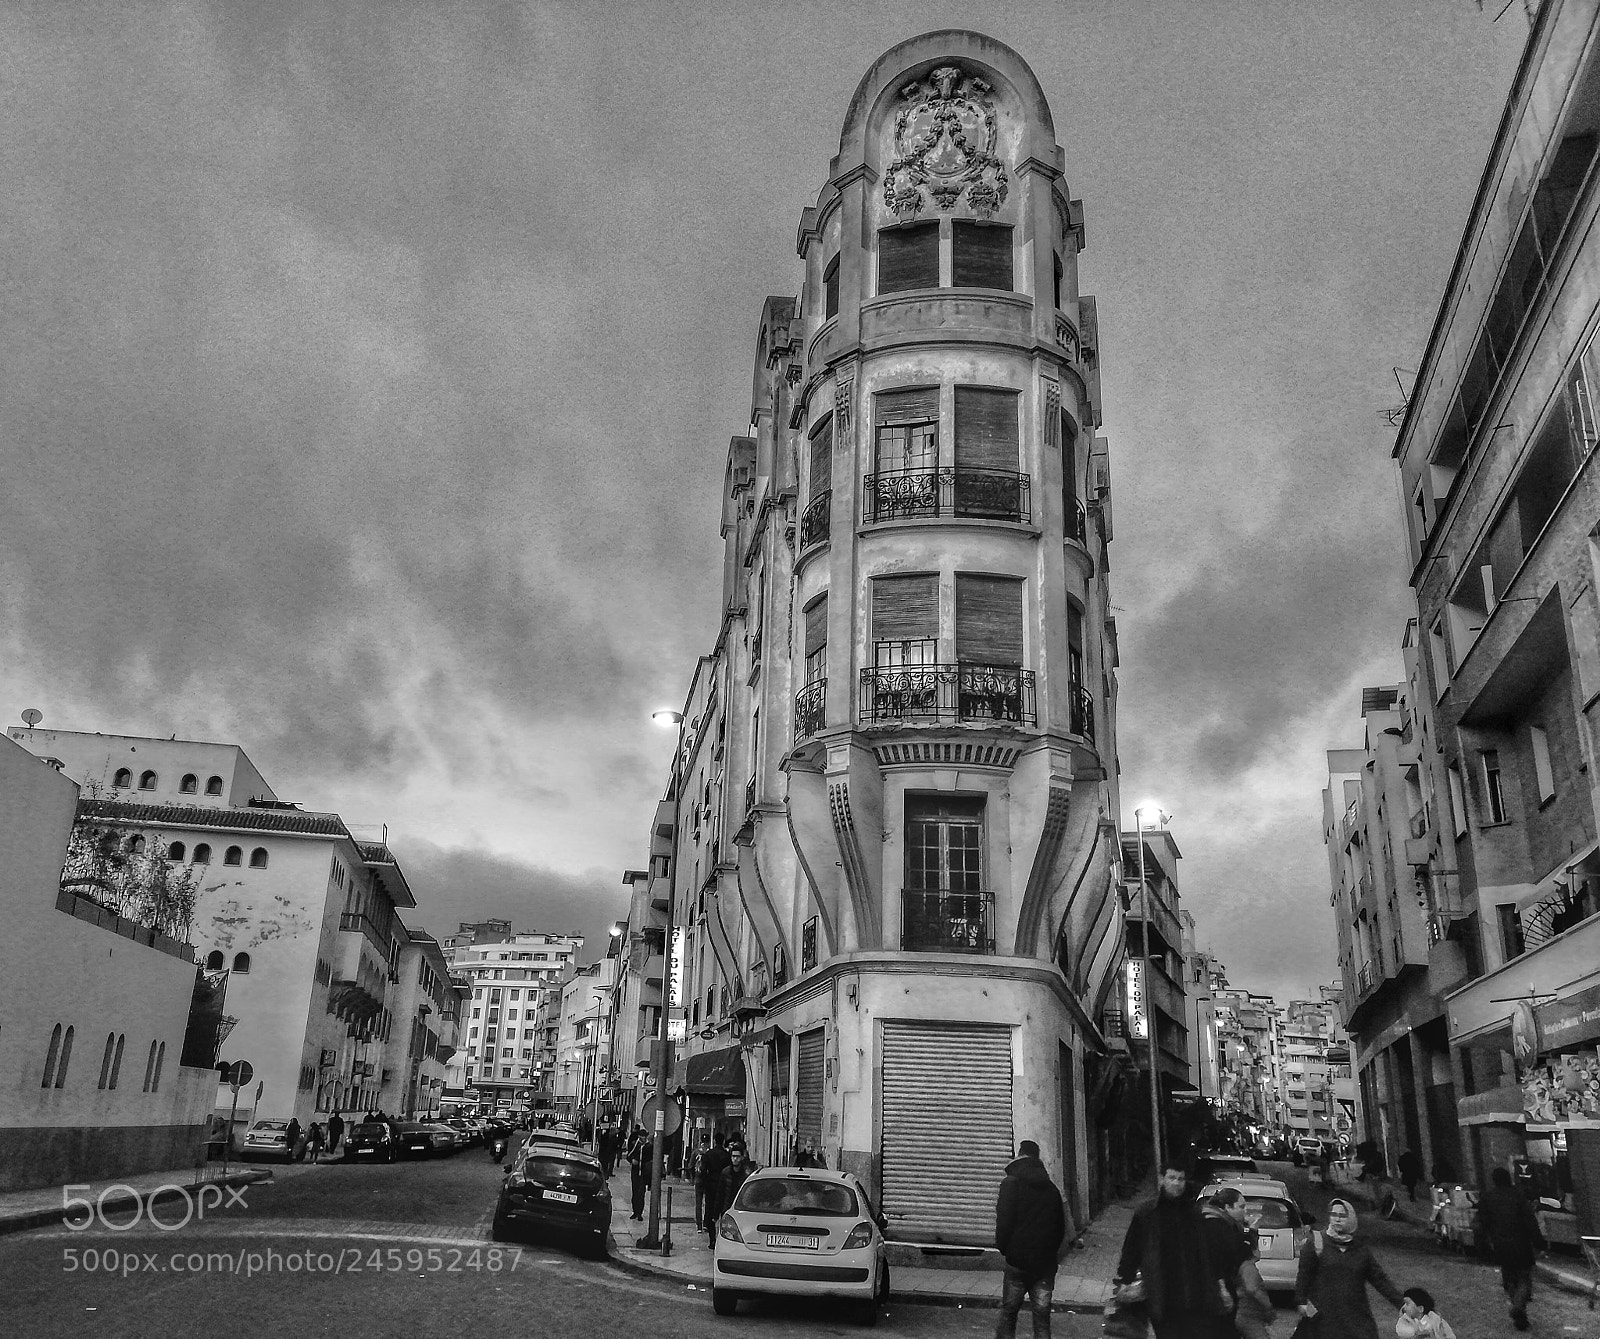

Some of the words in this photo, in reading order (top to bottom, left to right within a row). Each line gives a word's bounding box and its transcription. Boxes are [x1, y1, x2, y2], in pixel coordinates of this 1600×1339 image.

[1133, 961, 1141, 989] HOTEL
[1133, 990, 1142, 1002] DU
[1133, 1004, 1143, 1037] PALAIS
